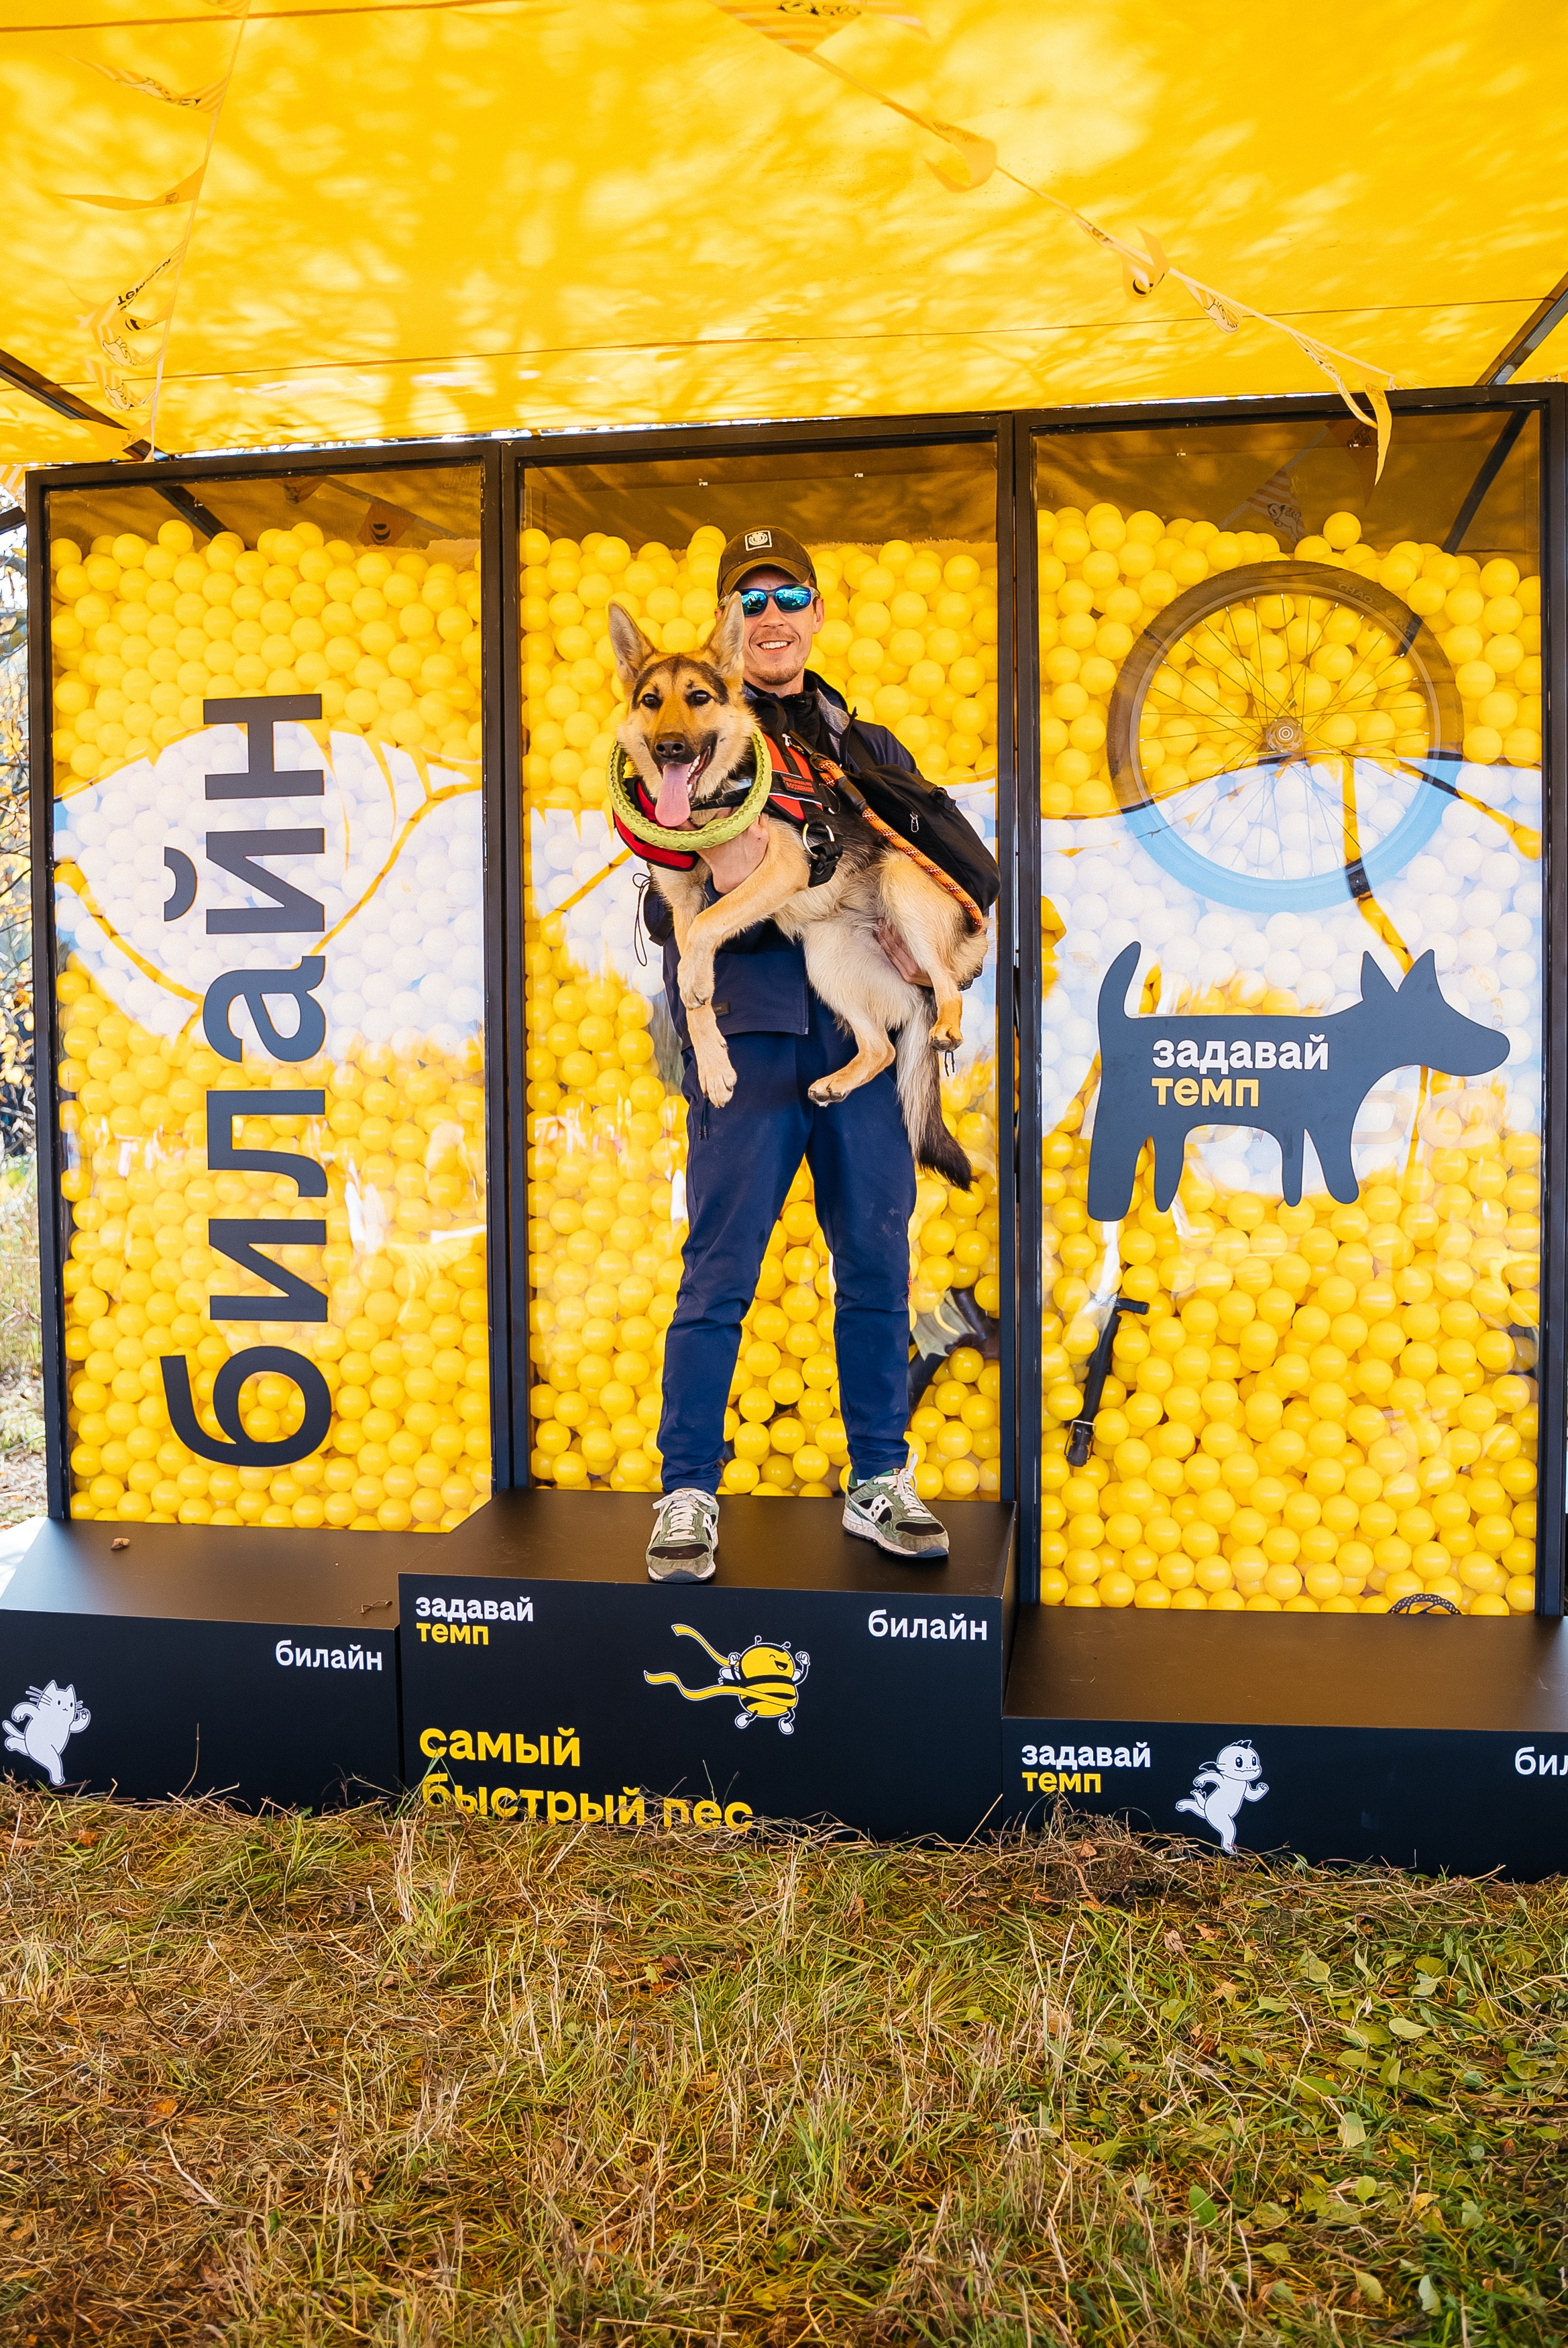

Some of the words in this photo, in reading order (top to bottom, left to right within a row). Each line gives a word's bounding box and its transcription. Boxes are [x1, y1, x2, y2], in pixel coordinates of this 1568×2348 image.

[1338, 583, 1374, 604] CHAO
[1152, 1034, 1329, 1075] задавай
[160, 694, 332, 1467] билайн
[1152, 1077, 1259, 1107] темп
[415, 1596, 534, 1623] задавай
[416, 1622, 489, 1646] темп
[868, 1609, 987, 1641] билайн
[275, 1640, 382, 1671] билайн
[419, 1727, 580, 1767] самый
[1021, 1742, 1151, 1771] задавай
[1021, 1770, 1101, 1793] темп
[422, 1772, 645, 1825] быстрый
[663, 1797, 752, 1832] пес
